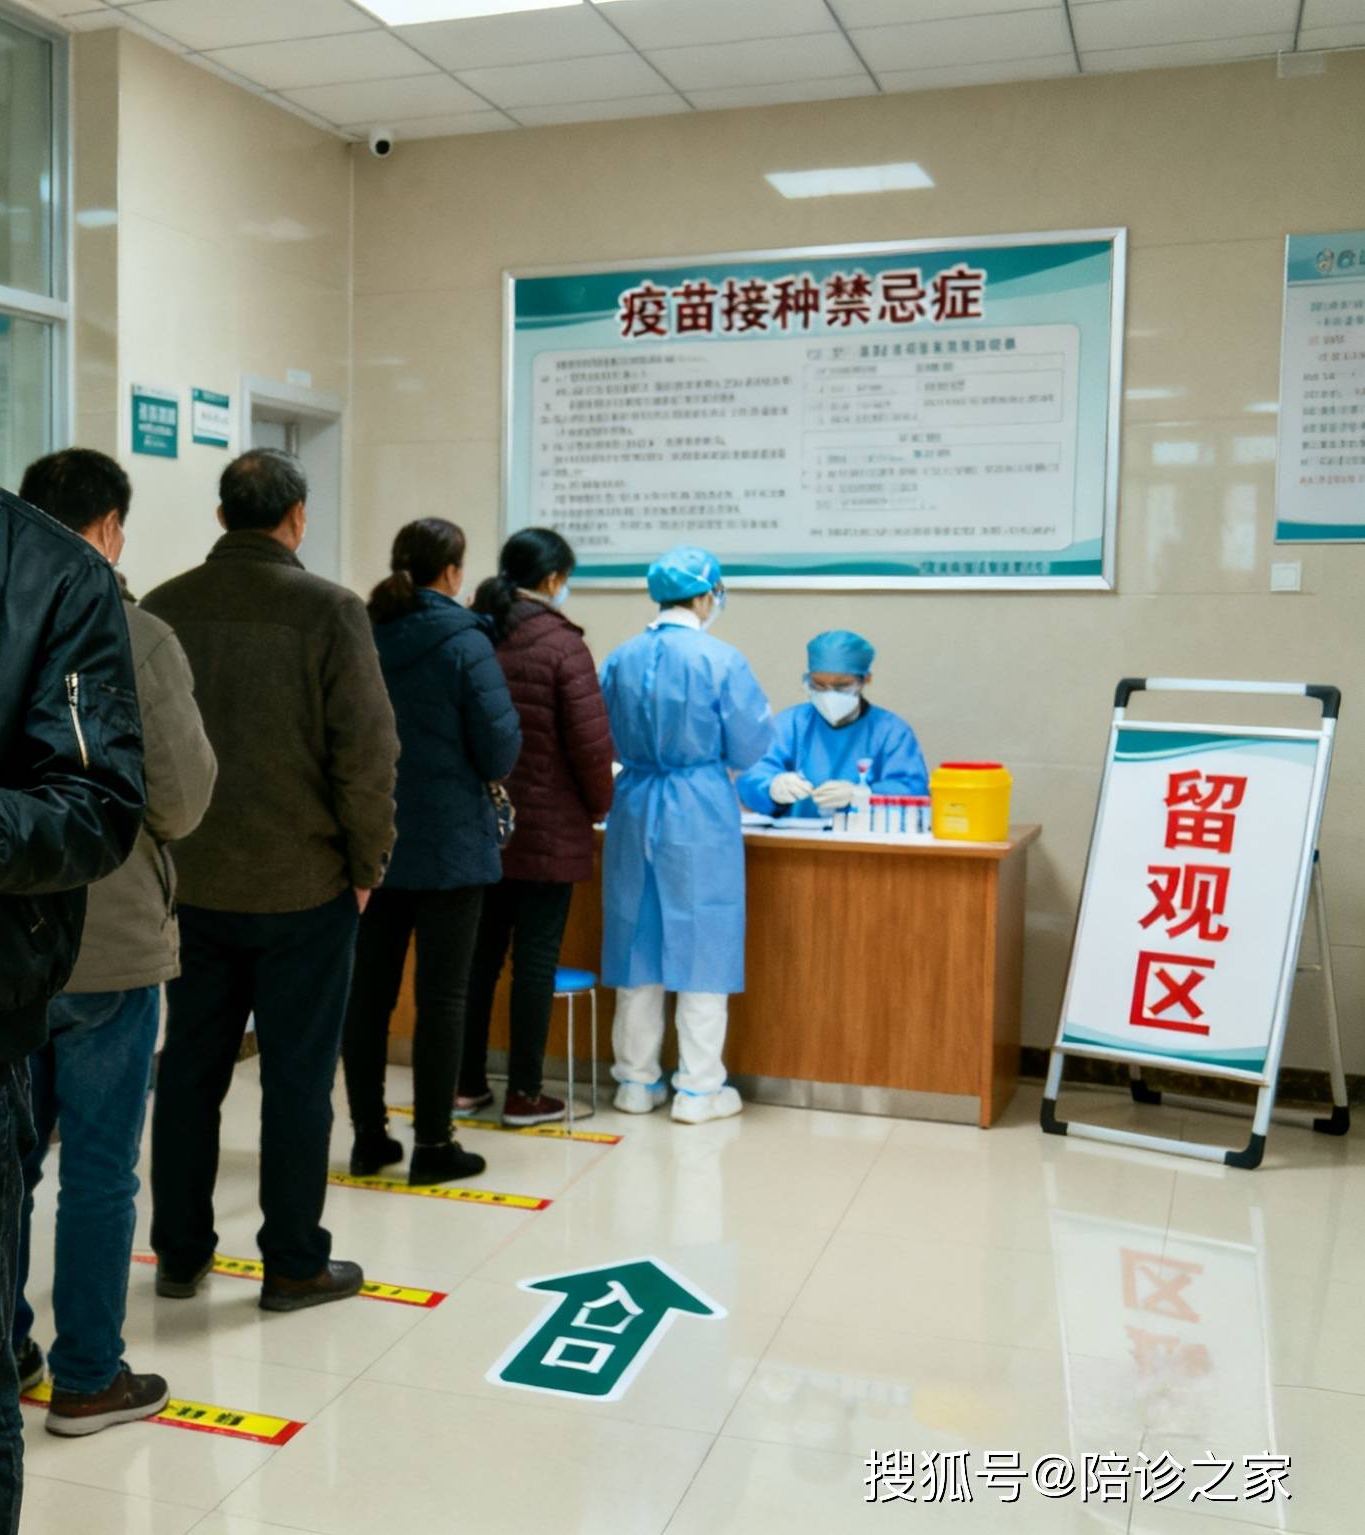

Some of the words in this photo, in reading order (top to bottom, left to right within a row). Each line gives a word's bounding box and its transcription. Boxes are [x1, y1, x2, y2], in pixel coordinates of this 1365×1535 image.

[619, 268, 983, 338] 疫苗接种禁忌症
[1129, 769, 1248, 1036] 留观区
